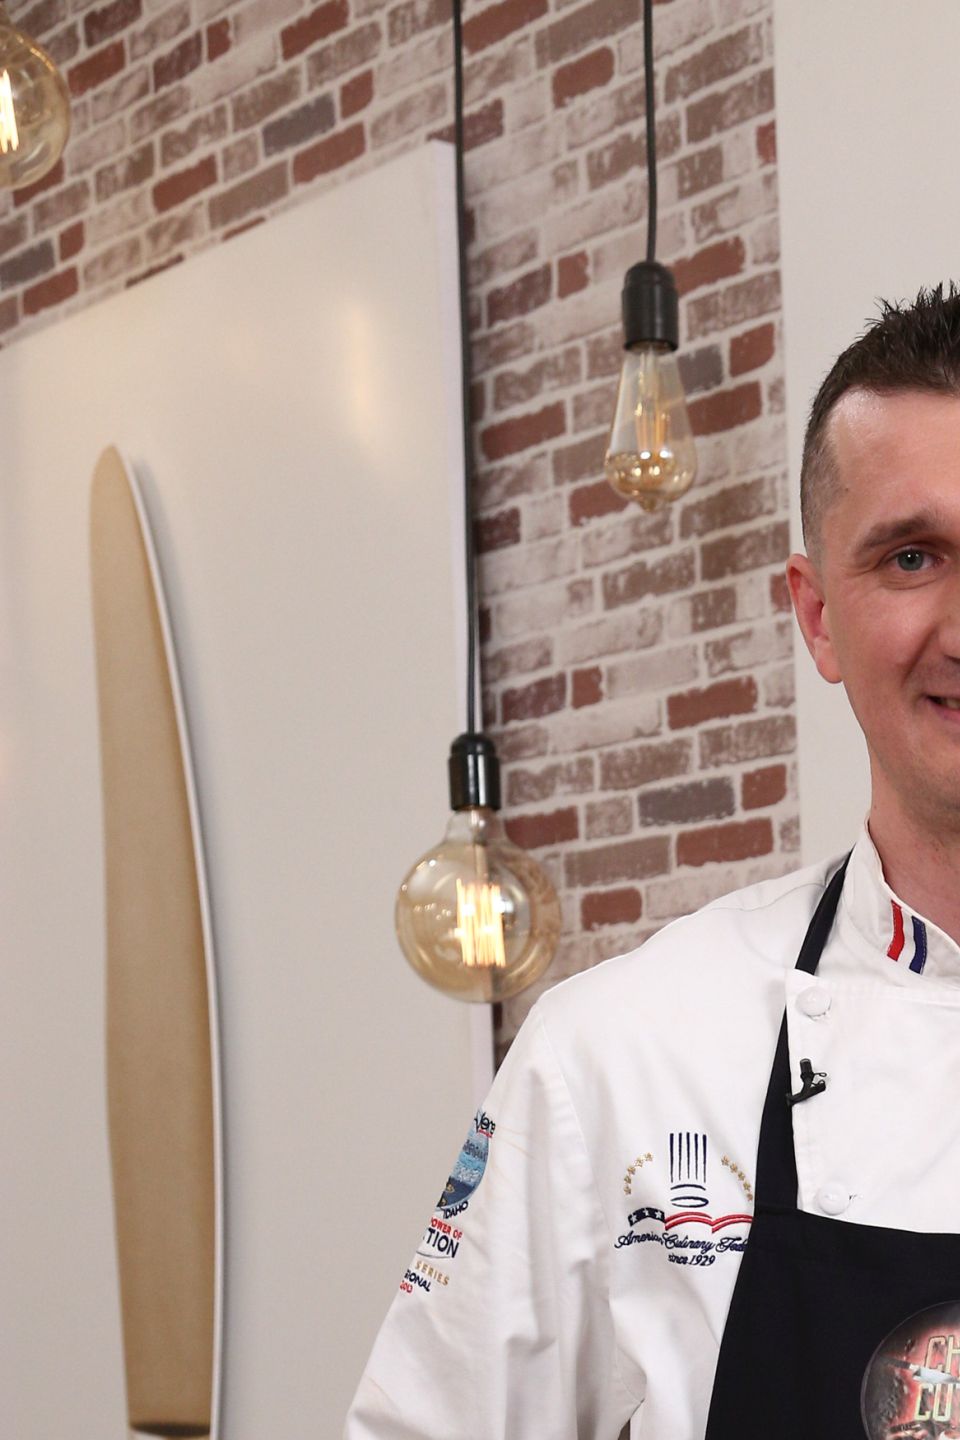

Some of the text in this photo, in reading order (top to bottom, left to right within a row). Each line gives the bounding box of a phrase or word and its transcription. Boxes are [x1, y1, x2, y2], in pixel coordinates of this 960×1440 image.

[431, 1217, 452, 1235] OWER
[424, 1228, 460, 1258] TION
[690, 1254, 716, 1267] 1929
[415, 1260, 450, 1287] SERIES
